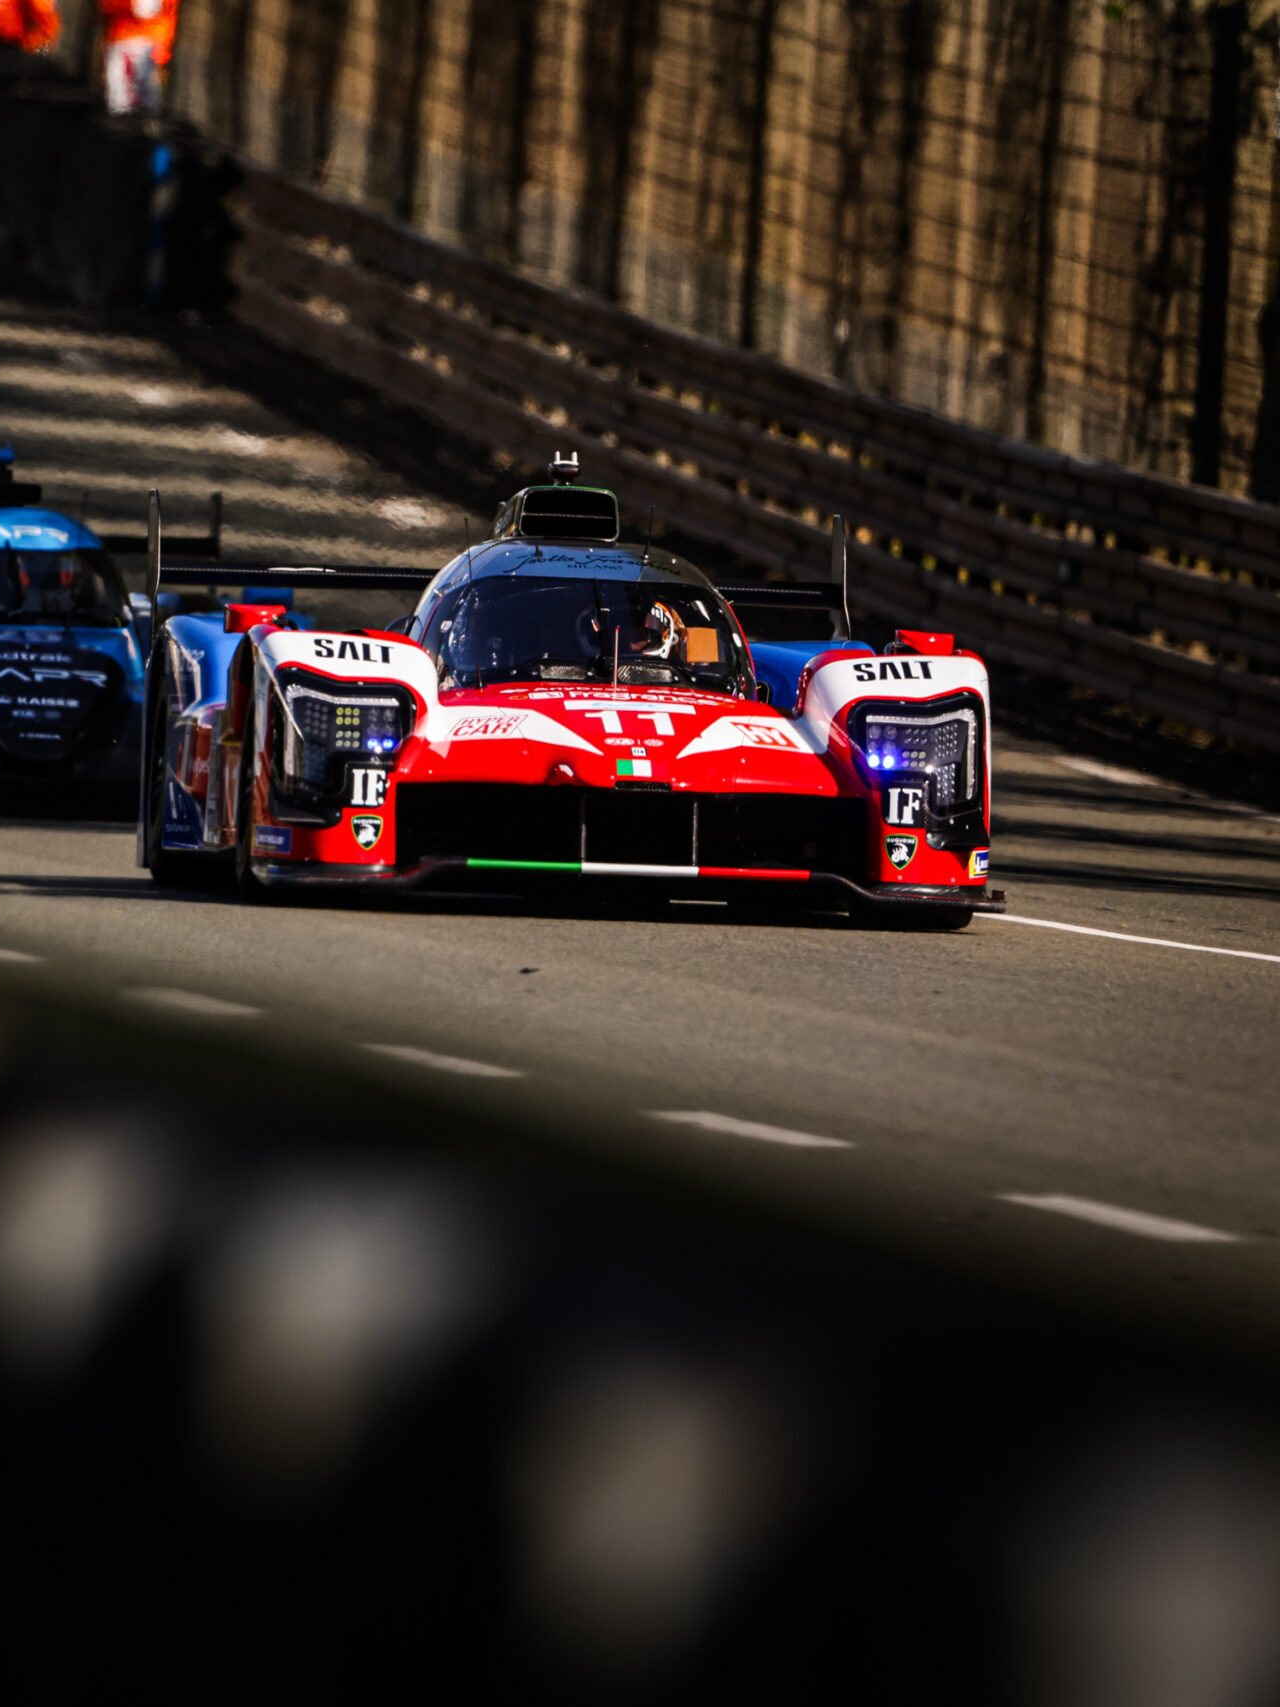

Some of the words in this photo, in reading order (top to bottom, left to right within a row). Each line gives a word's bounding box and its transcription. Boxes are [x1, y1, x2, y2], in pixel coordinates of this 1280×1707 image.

[567, 564, 624, 572] MILANO
[313, 638, 394, 664] SALT
[853, 660, 933, 682] SALT
[17, 696, 79, 708] KAISER
[569, 691, 720, 707] Fragrance
[452, 723, 513, 737] CAR
[460, 715, 520, 725] HYPER
[584, 709, 676, 736] 11
[735, 724, 788, 746] HY
[351, 768, 387, 807] IF
[886, 787, 923, 825] IF
